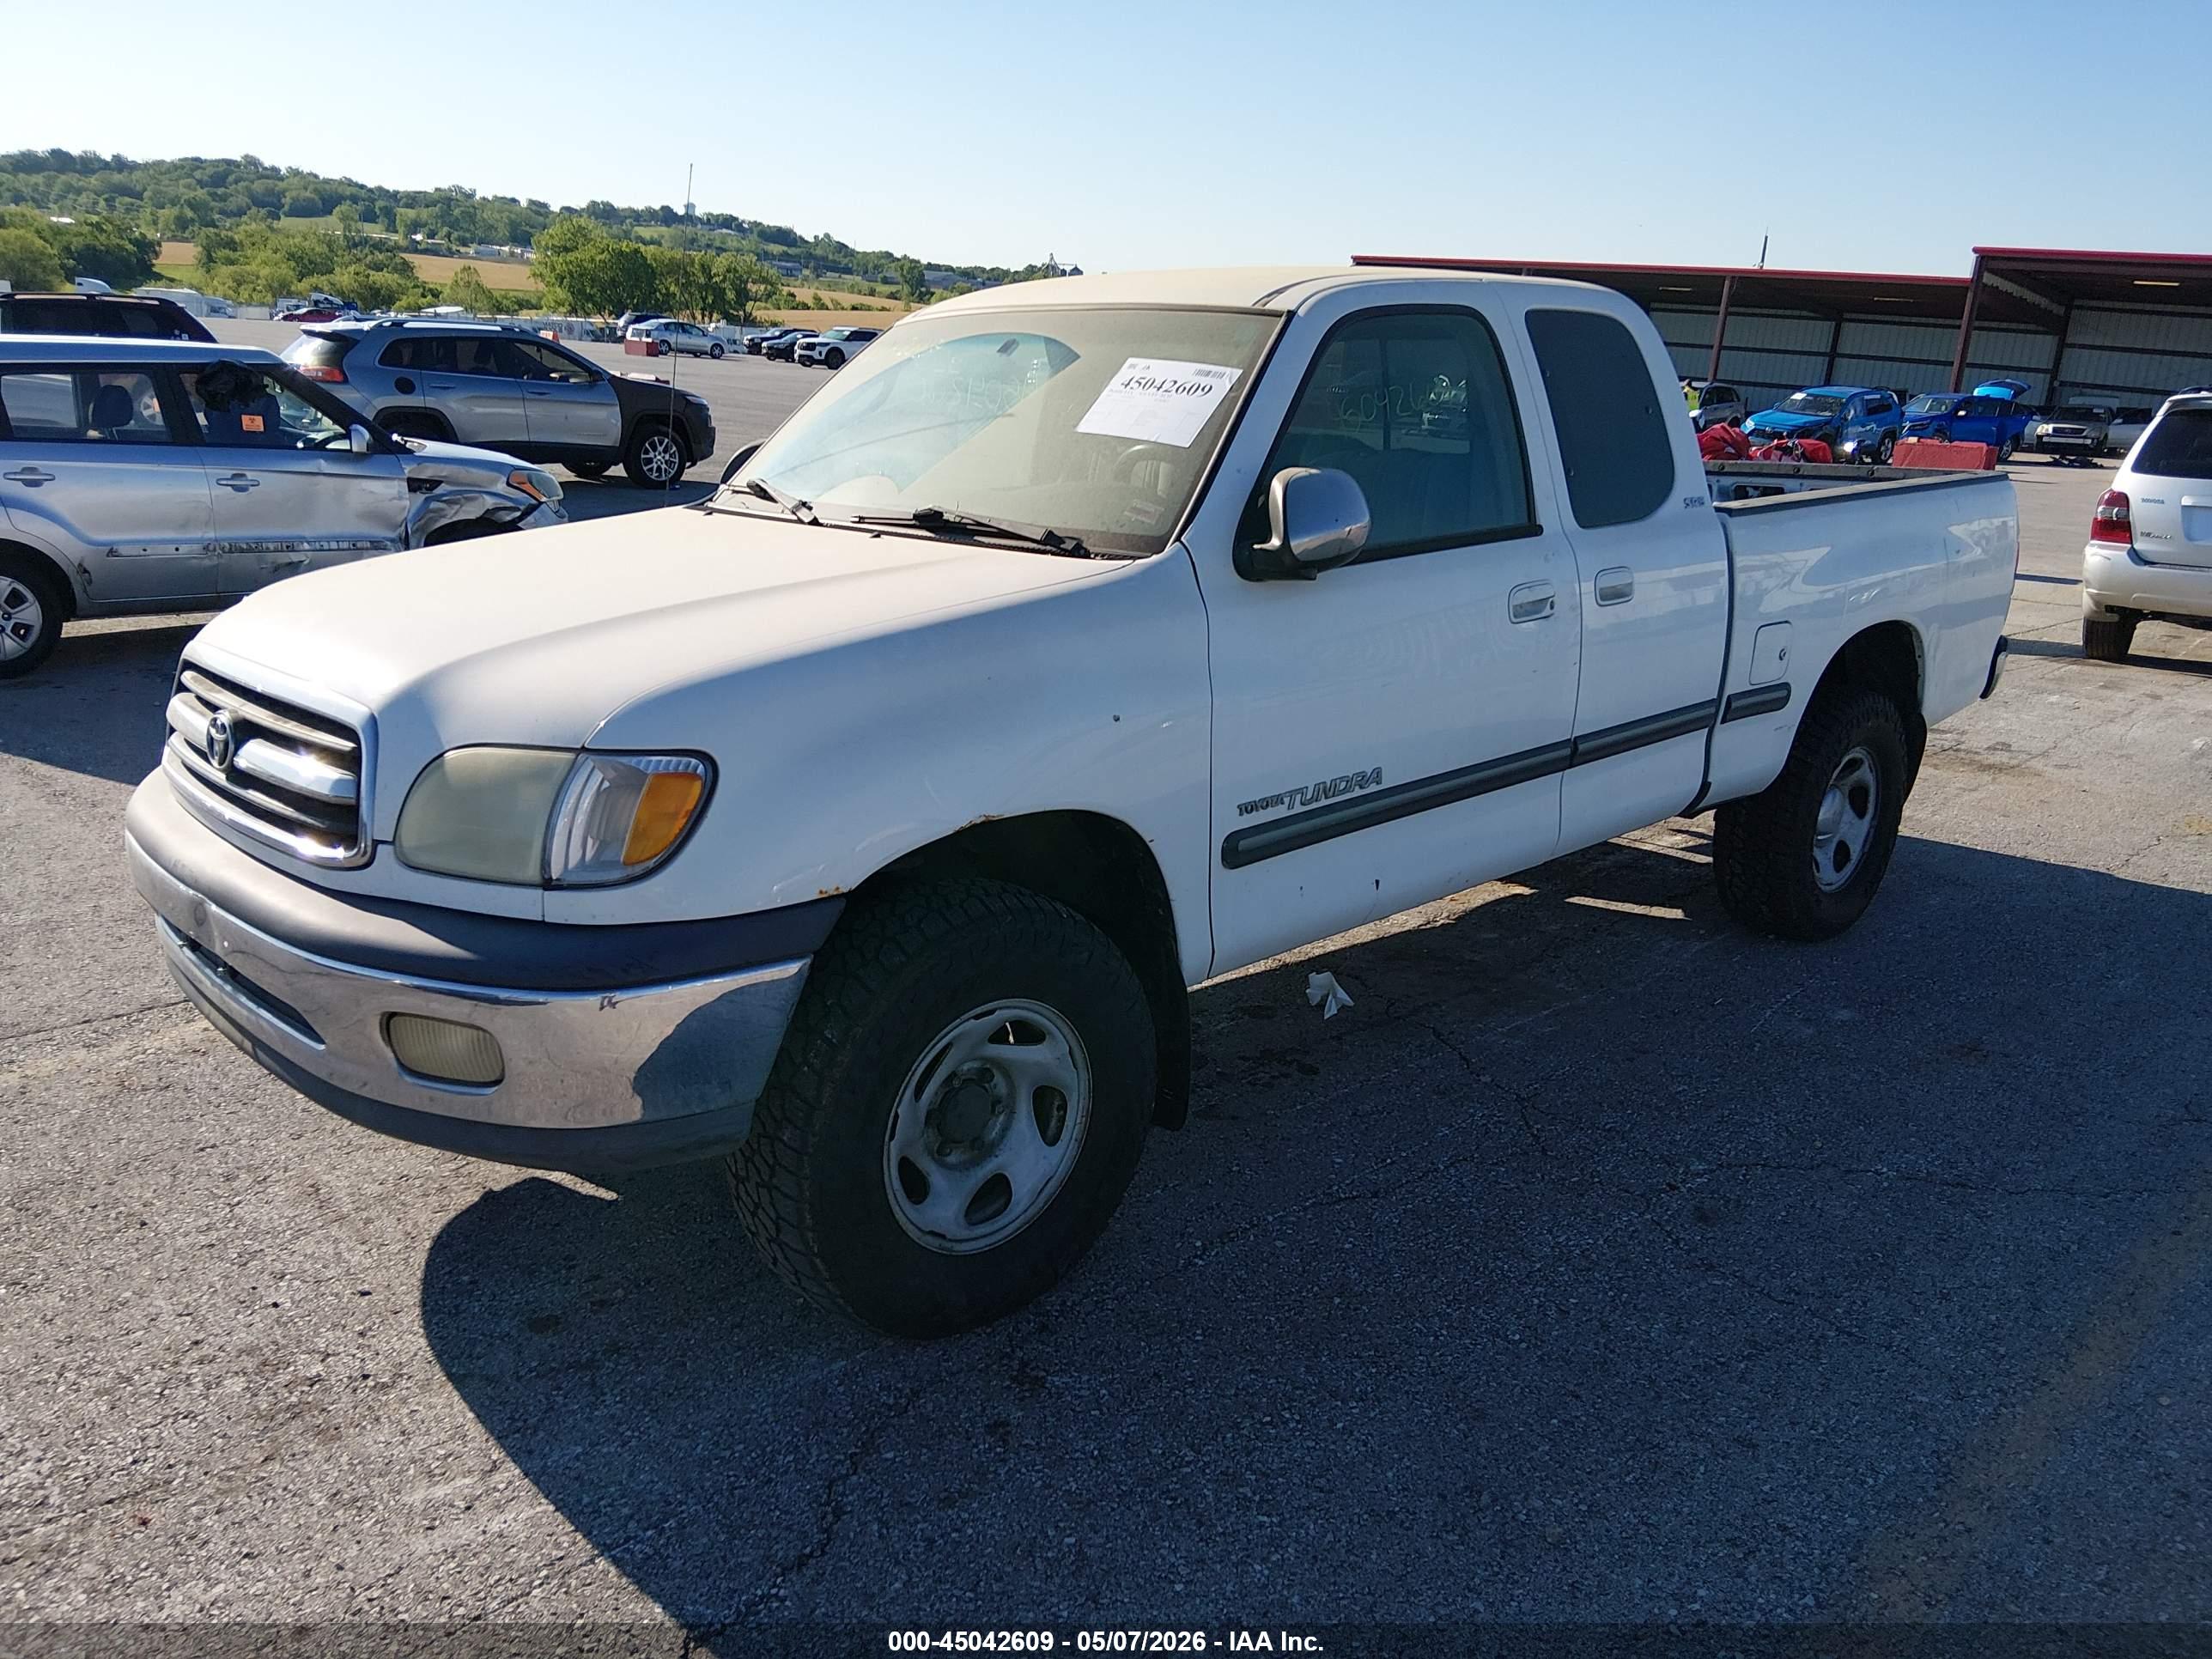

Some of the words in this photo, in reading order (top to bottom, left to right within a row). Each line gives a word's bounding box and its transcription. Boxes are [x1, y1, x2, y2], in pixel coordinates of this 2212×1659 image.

[1120, 376, 1214, 398] 45042609
[1237, 793, 1285, 817] TOYOTA
[1284, 766, 1383, 811] TUNDRA
